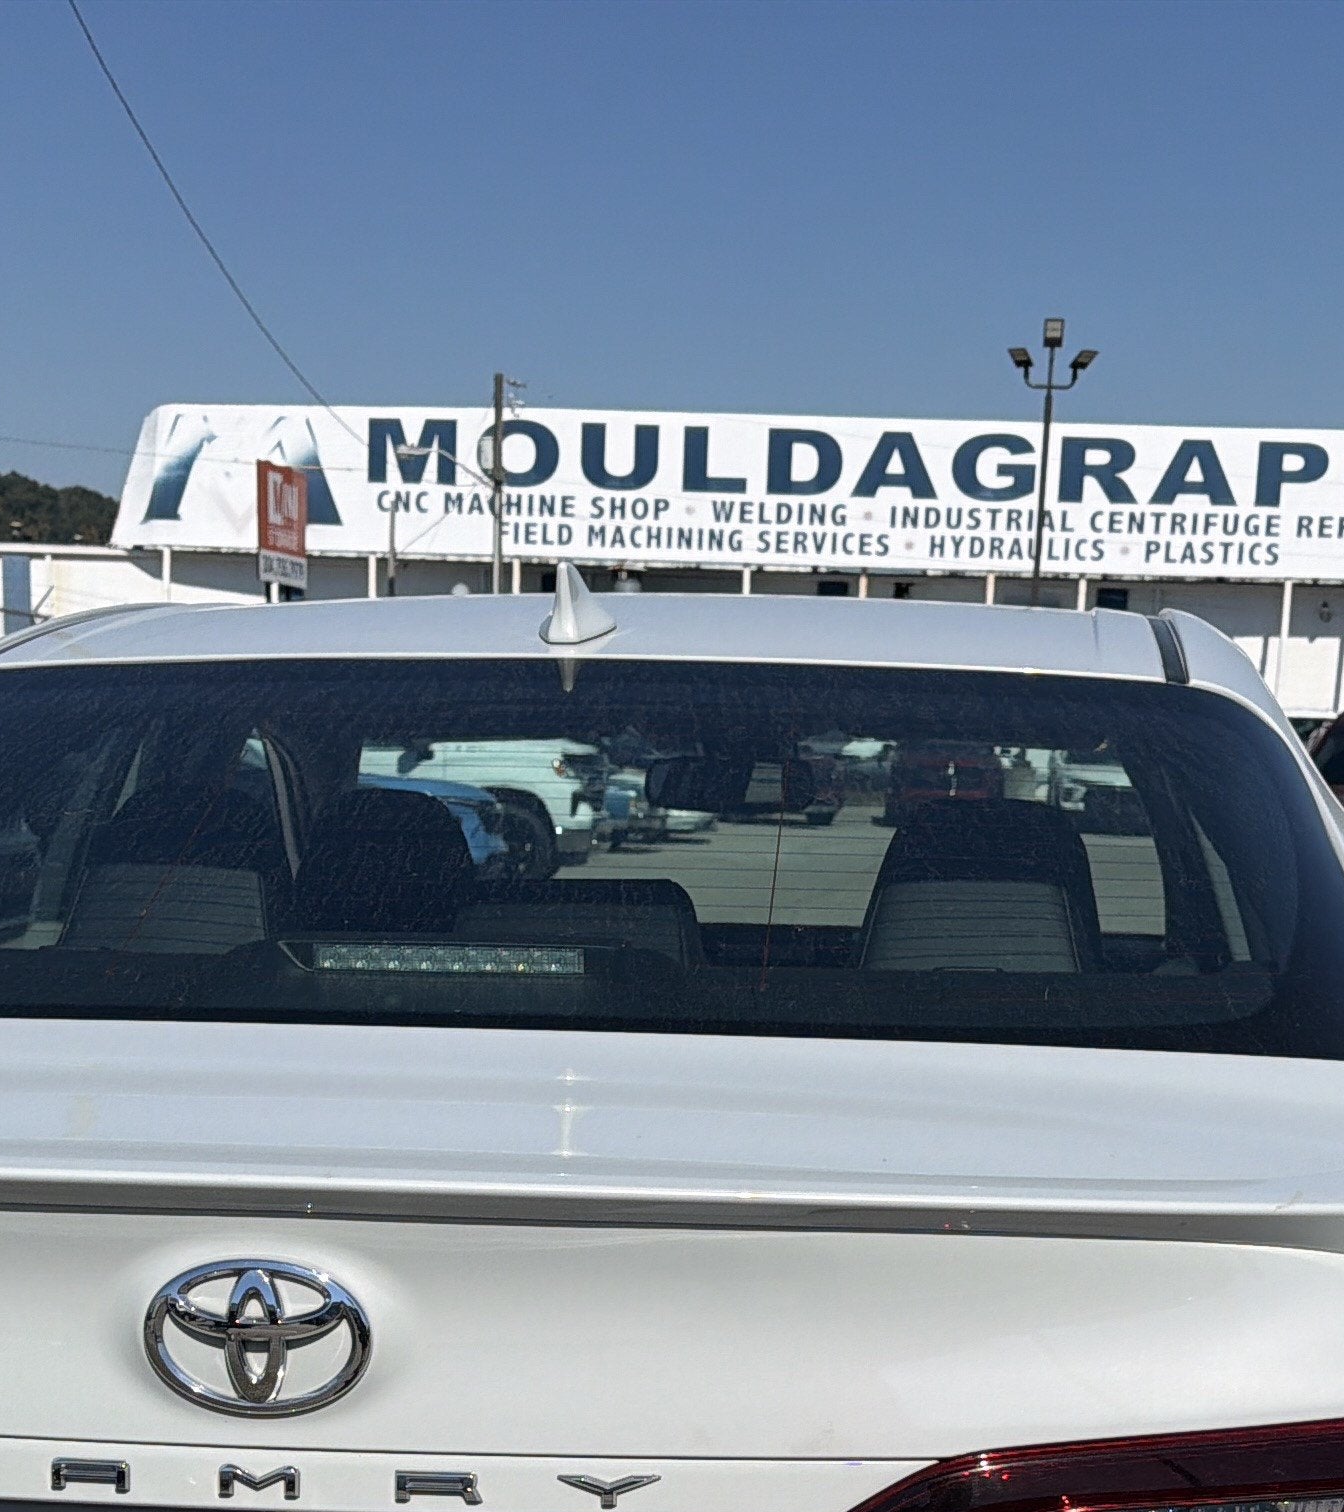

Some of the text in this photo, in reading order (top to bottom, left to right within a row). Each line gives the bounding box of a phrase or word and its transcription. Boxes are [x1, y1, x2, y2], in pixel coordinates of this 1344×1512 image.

[377, 490, 429, 514] CNC
[590, 496, 670, 521] SHOP
[711, 499, 849, 527] WELDING
[889, 505, 1075, 533] INDUSTRIAL
[1089, 510, 1281, 538] CENTRIFUGE
[499, 521, 1280, 566] FIELD MACHINING SERVICES HYDRAULICS PLASTICS
